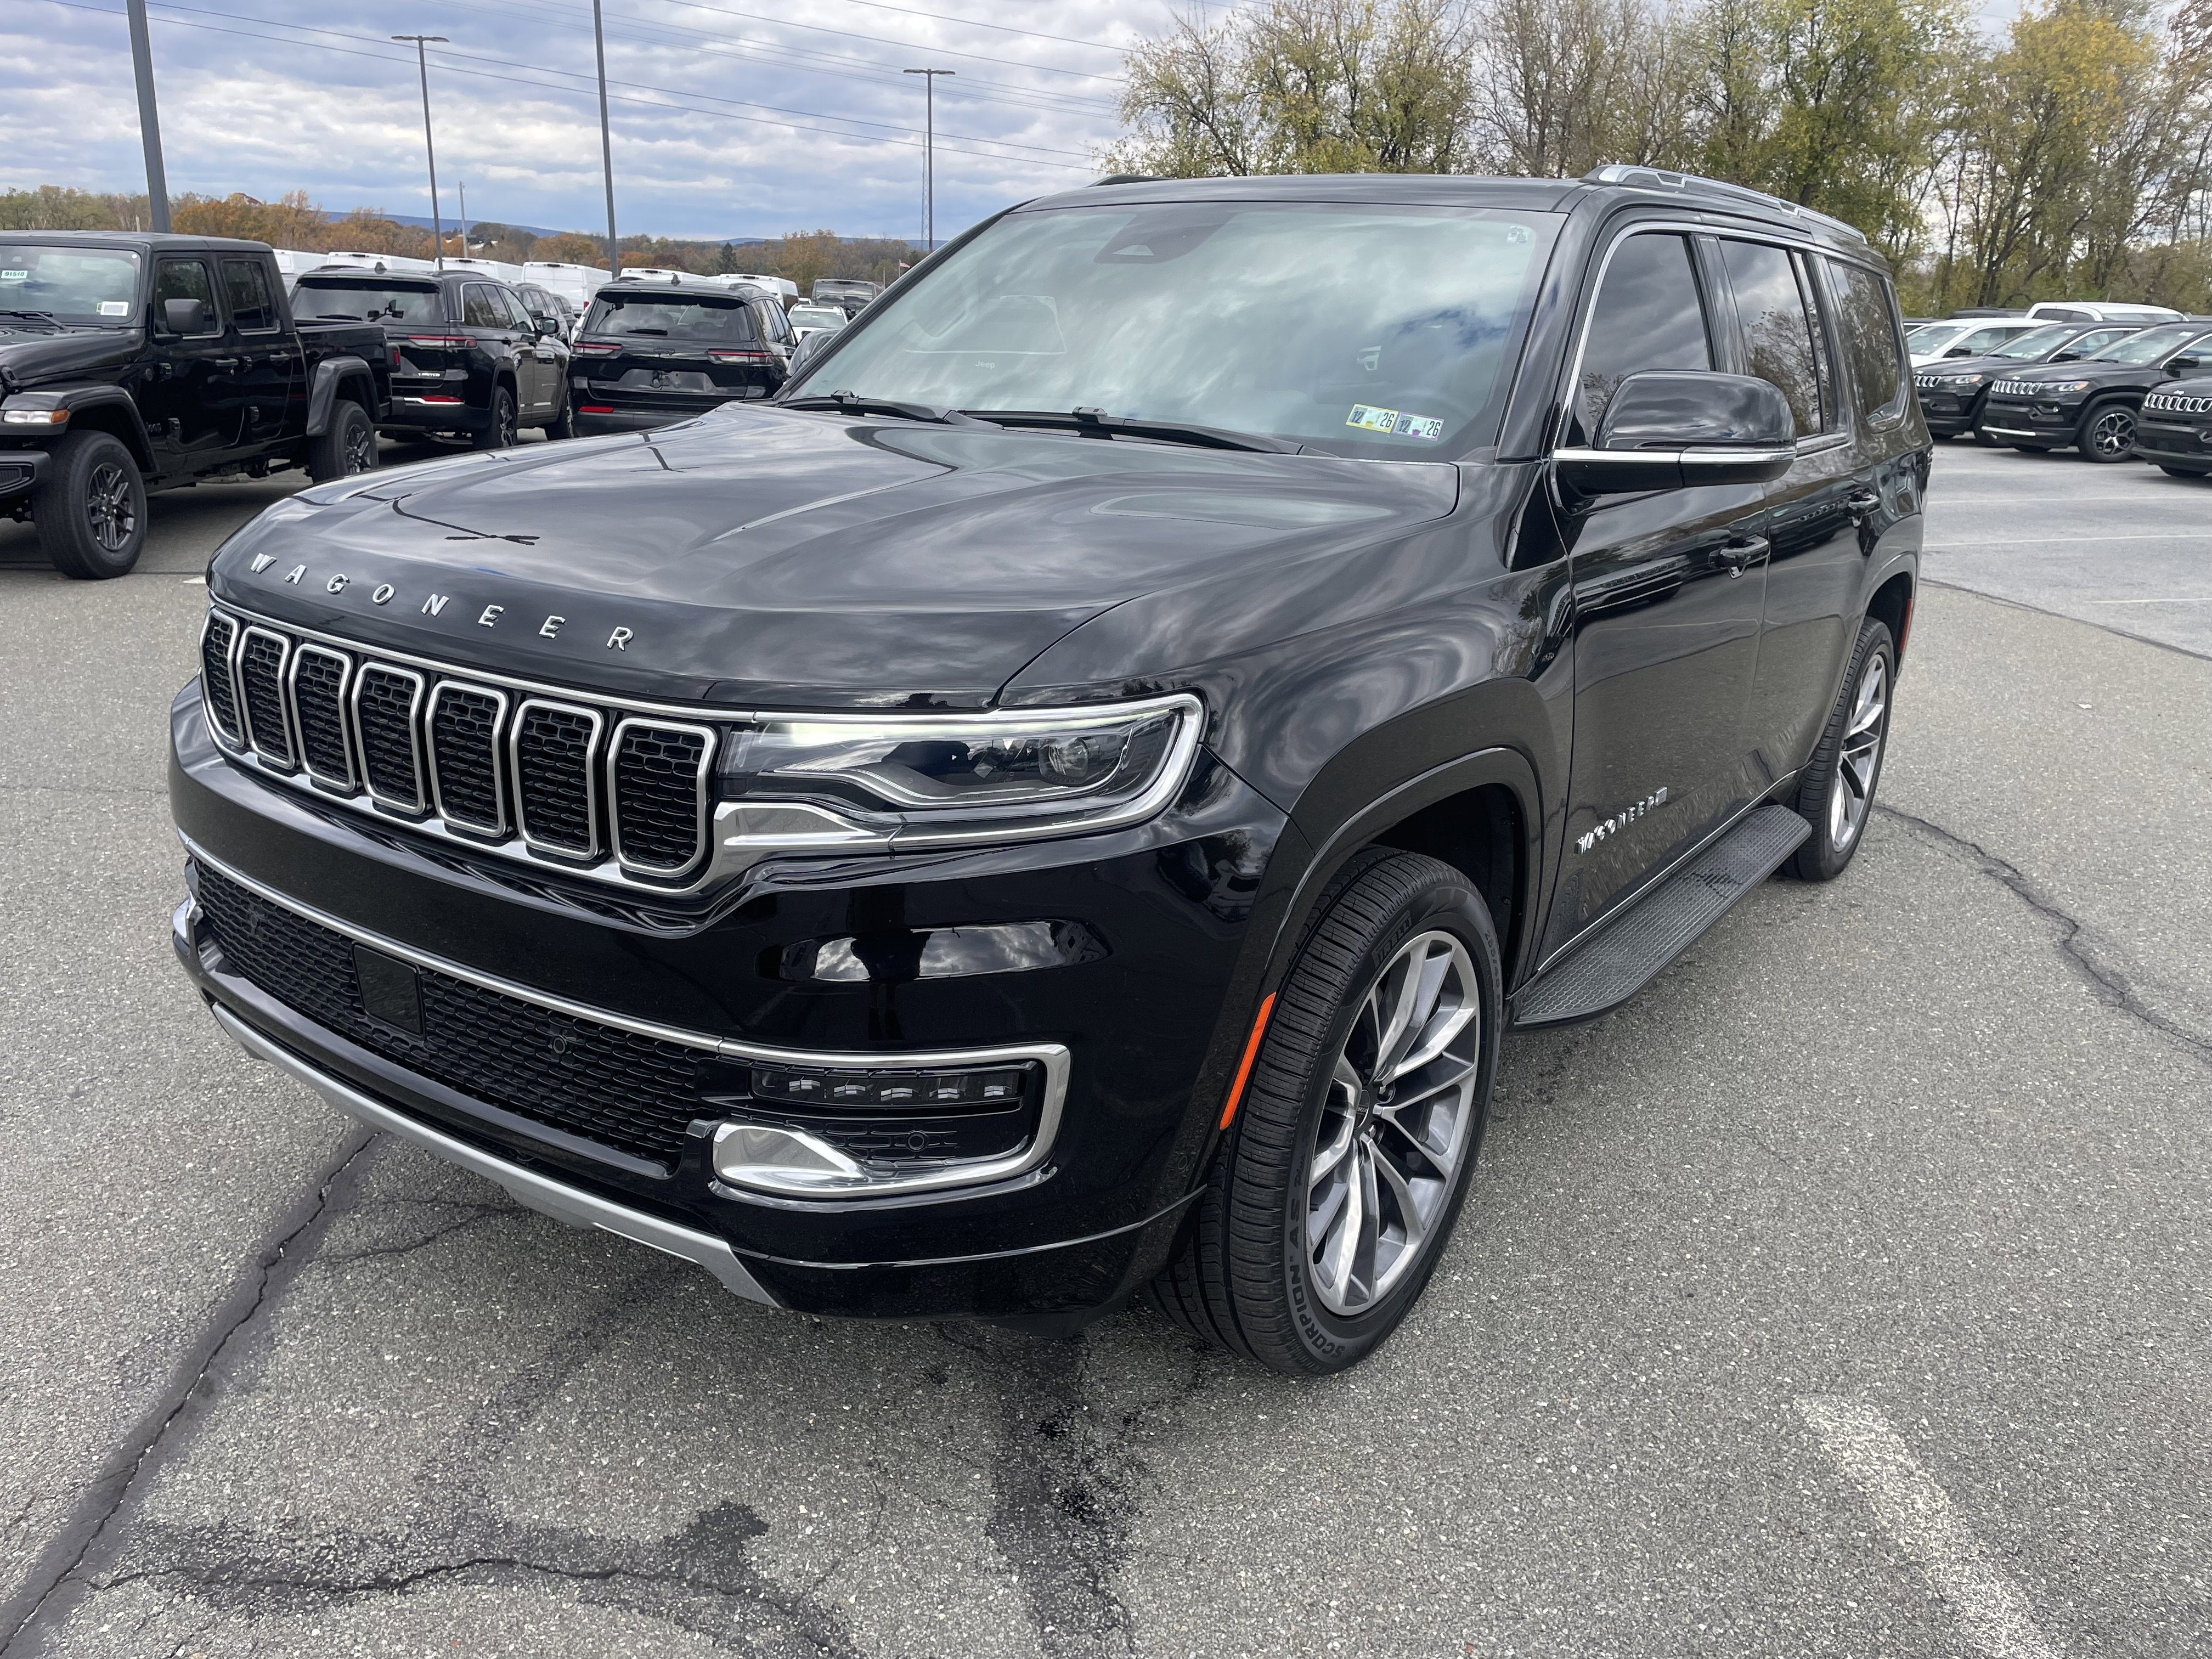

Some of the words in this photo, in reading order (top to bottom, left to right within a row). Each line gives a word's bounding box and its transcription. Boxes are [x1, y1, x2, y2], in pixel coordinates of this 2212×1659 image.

[974, 360, 995, 369] Jeep
[1351, 410, 1365, 424] 12
[1379, 412, 1395, 428] 26
[1398, 419, 1411, 433] 12
[1426, 420, 1441, 437] 26
[250, 552, 634, 651] WAGONEER
[1290, 1199, 1300, 1249] AS
